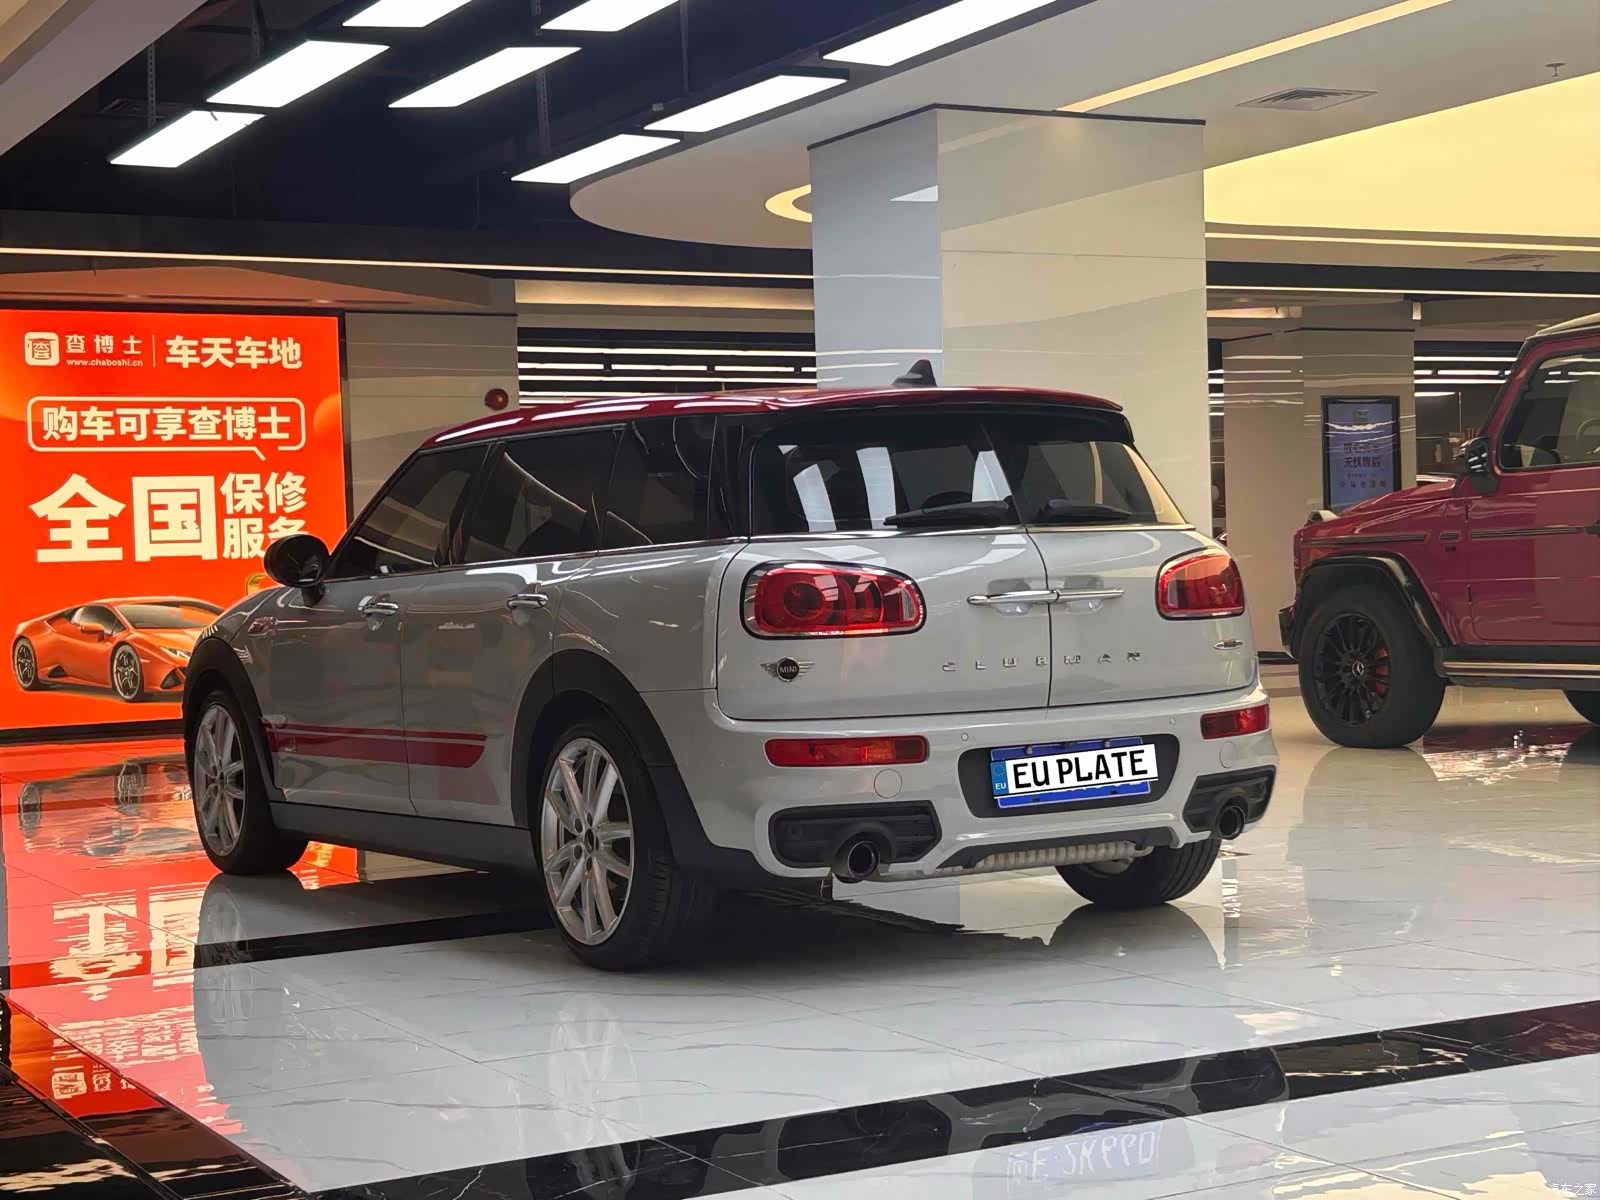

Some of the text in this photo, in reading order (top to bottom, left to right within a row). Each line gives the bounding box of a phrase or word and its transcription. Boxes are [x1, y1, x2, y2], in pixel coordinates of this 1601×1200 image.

[65, 334, 142, 354] 查博士
[166, 335, 302, 369] 车天车地
[66, 358, 143, 367] www.chaboshi.cn
[43, 406, 291, 441] 购车可享查博士
[220, 472, 307, 514] 保修
[29, 474, 218, 562] 全国
[780, 665, 797, 673] MINI
[942, 650, 1140, 672] CLUBMAN
[1013, 749, 1148, 789] EU PLATE
[995, 782, 1007, 790] EU
